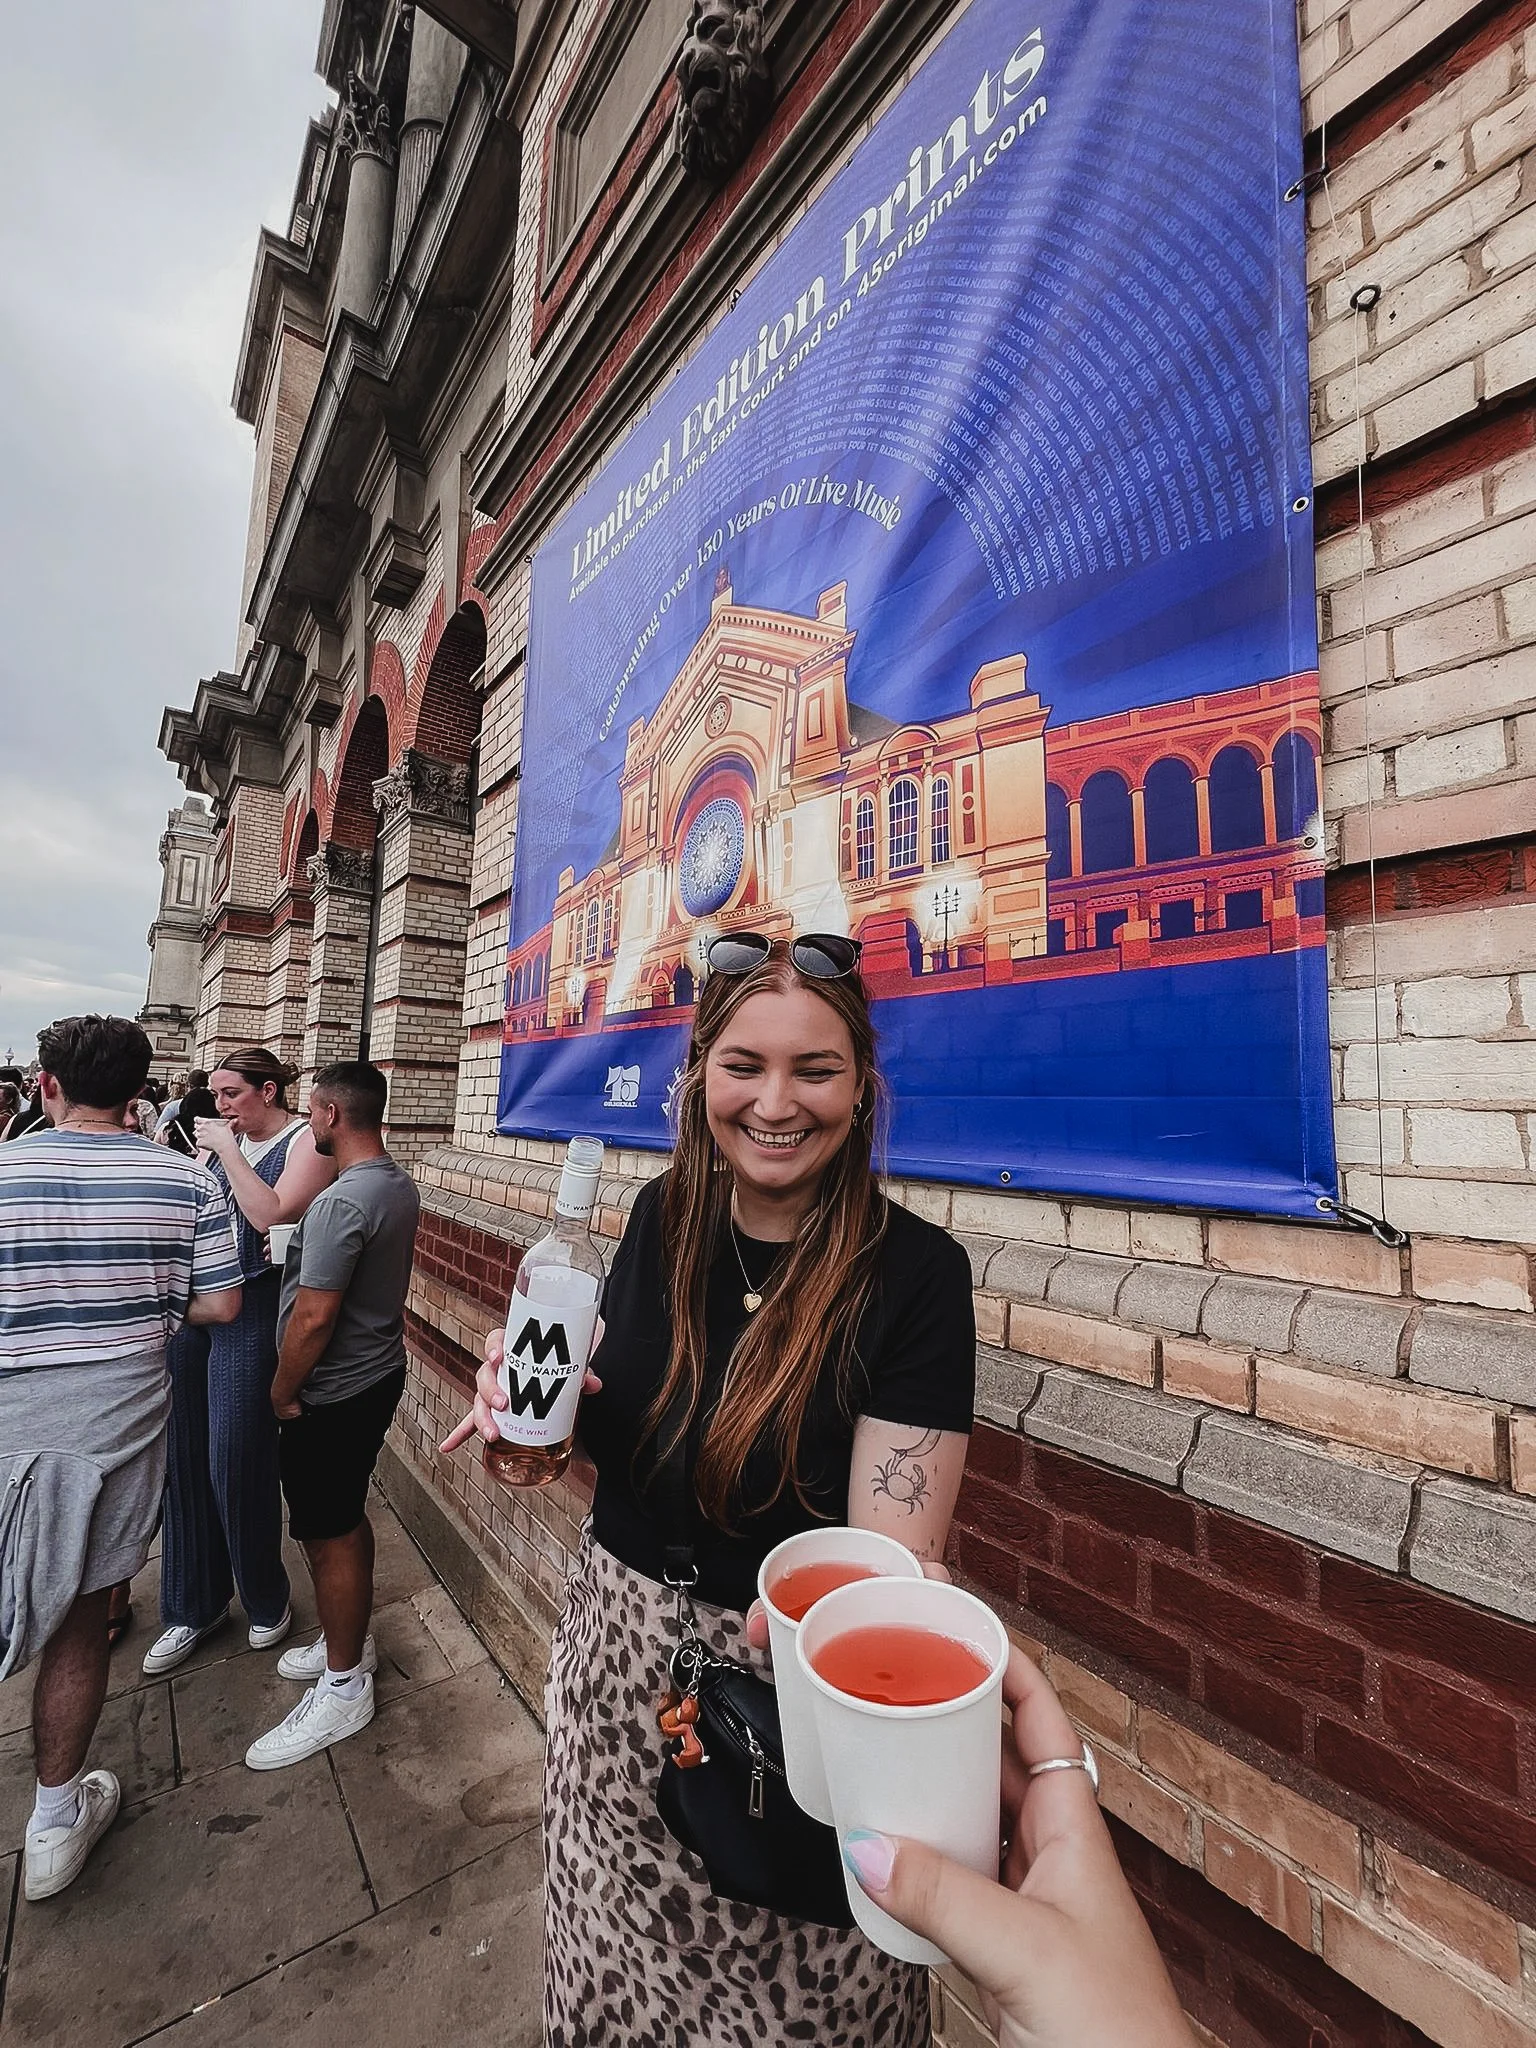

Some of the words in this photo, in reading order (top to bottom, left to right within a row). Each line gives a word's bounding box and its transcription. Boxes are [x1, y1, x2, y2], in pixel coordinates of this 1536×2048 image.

[1054, 212, 1074, 227] THE
[1070, 241, 1094, 261] KOJO
[1226, 239, 1245, 261] BIG
[1091, 253, 1118, 278] FUNDS
[1126, 249, 1181, 307] SYNCOPATORS
[1127, 281, 1154, 312] DOOM
[1203, 252, 1220, 272] GO
[1214, 266, 1231, 287] GO
[1225, 281, 1260, 332] PENGUIN
[570, 441, 671, 581] Limited
[680, 277, 826, 463] Edition
[840, 27, 1046, 286] Prints
[1150, 306, 1169, 329] THE
[1178, 301, 1210, 346] GARETH
[568, 556, 609, 602] Available
[610, 542, 622, 559] to
[622, 491, 670, 552] purchase
[672, 478, 684, 494] in
[686, 451, 707, 475] the
[710, 415, 737, 454] East
[740, 367, 785, 419] Court
[786, 330, 821, 373] and
[825, 299, 852, 332] on
[856, 96, 1047, 298] 45original.com
[1136, 226, 1179, 267] YUNGBLUD
[1176, 262, 1197, 286] ROY
[1192, 279, 1218, 313] AYERS
[1213, 308, 1250, 366] BENJAMIN
[1242, 361, 1271, 415] BOOKER
[1262, 414, 1282, 449] DICK
[1163, 323, 1185, 351] LAST
[1202, 339, 1234, 392] MALONE
[1178, 346, 1210, 398] SHADOW
[1015, 308, 1044, 332] DANNY
[1060, 340, 1106, 395] COUNTERFEIT
[1103, 392, 1120, 416] TEN
[1114, 411, 1136, 447] YEARS
[1130, 443, 1150, 482] AFTER
[1144, 482, 1171, 557] HATEBREED
[1024, 290, 1048, 310] KYLE
[1047, 303, 1062, 319] WE
[1077, 327, 1090, 342] AS
[1086, 335, 1118, 374] ROMANS
[1114, 369, 1131, 393] JOE
[1126, 388, 1143, 413] KAY
[1138, 410, 1158, 446] TONY
[1152, 442, 1168, 470] COE
[1162, 470, 1190, 551] ARCHITECTS
[1074, 295, 1102, 324] HEARTS
[1099, 317, 1122, 344] WAKE
[1120, 340, 1140, 366] BETH
[1135, 361, 1161, 400] ORTON
[1156, 398, 1179, 439] TRAVIS
[1173, 438, 1198, 490] SOCCER
[1189, 489, 1211, 546] MOMMY
[1130, 318, 1147, 339] THE
[1142, 333, 1160, 357] FUN
[1173, 384, 1204, 441] CRIMINAL
[1197, 441, 1218, 484] JAMES
[1210, 481, 1232, 540] LAVELLE
[1203, 394, 1232, 451] PUPPETS
[1227, 390, 1245, 420] SEA
[1237, 416, 1258, 458] GIRLS
[981, 355, 1010, 380] ARTFUL
[1033, 399, 1059, 433] CURVED
[1055, 428, 1069, 448] AIR
[1065, 444, 1083, 473] RUBY
[1077, 470, 1097, 506] BRAFF
[1091, 505, 1107, 539] LORD
[1100, 537, 1115, 571] TUSK
[983, 335, 1028, 370] ARCHITECTS
[1042, 379, 1061, 402] WILD
[1059, 399, 1081, 431] URIAH
[1076, 426, 1095, 455] HEEP
[1090, 453, 1114, 497] GHETTS
[1107, 496, 1134, 566] PUMAROSA
[997, 320, 1034, 349] SPECTOR
[1060, 369, 1083, 398] STARE
[1080, 393, 1105, 432] KHALID
[1101, 429, 1128, 479] SWEDISH
[1121, 475, 1142, 520] HOUSE
[1134, 518, 1152, 560] MAFIA
[1224, 450, 1238, 471] AL
[897, 401, 921, 415] GHOST
[949, 421, 964, 437] THE
[961, 430, 978, 449] BAD
[975, 443, 995, 469] SEEDS
[992, 465, 1015, 500] ARCADE
[1011, 494, 1025, 518] FIRE
[1020, 515, 1038, 548] DAVID
[1032, 545, 1050, 589] GUETTA
[899, 386, 909, 395] ED
[974, 417, 989, 435] LED
[987, 430, 1014, 465] ZEPPELIN
[1011, 461, 1035, 499] ORBITAL
[1031, 497, 1048, 528] OZZY
[1042, 524, 1066, 584] OSBOURNE
[978, 375, 1010, 405] SKINNER
[1008, 399, 1035, 432] ANGELIC
[1031, 427, 1060, 471] UPSTARTS
[1056, 468, 1071, 492] THE
[1064, 487, 1098, 574] CHAINSMOKERS
[979, 398, 996, 417] HOT
[994, 411, 1011, 432] CHIP
[1009, 428, 1031, 458] GOJIRA
[1028, 454, 1043, 476] THE
[1037, 471, 1065, 524] CHEMICAL
[1058, 520, 1082, 579] BROTHERS
[1229, 469, 1253, 534] STEWART
[1250, 458, 1267, 491] THE
[848, 441, 866, 449] FOUR
[936, 477, 955, 500] PINK
[952, 494, 972, 523] FLOYD
[969, 520, 988, 553] ARCTIC
[982, 548, 1005, 601] MONKEYS
[944, 439, 961, 457] LIPA
[959, 452, 978, 475] LIAM
[974, 469, 1005, 515] GALLAGHER
[1001, 513, 1019, 546] BLACK
[1014, 544, 1035, 592] SABBATH
[946, 464, 962, 483] THE
[958, 476, 985, 513] MACHINE
[981, 510, 1004, 550] VAMPIRE
[998, 545, 1020, 597] WEEKEND
[1257, 487, 1275, 528] USED
[599, 611, 661, 743] Celebrating
[659, 563, 693, 614] Over
[697, 529, 723, 569] 150
[727, 495, 777, 540] Years
[780, 479, 806, 510] Of
[805, 474, 848, 505] Live
[848, 480, 903, 532] Music
[511, 1316, 571, 1366] M
[532, 1364, 580, 1376] WANTED
